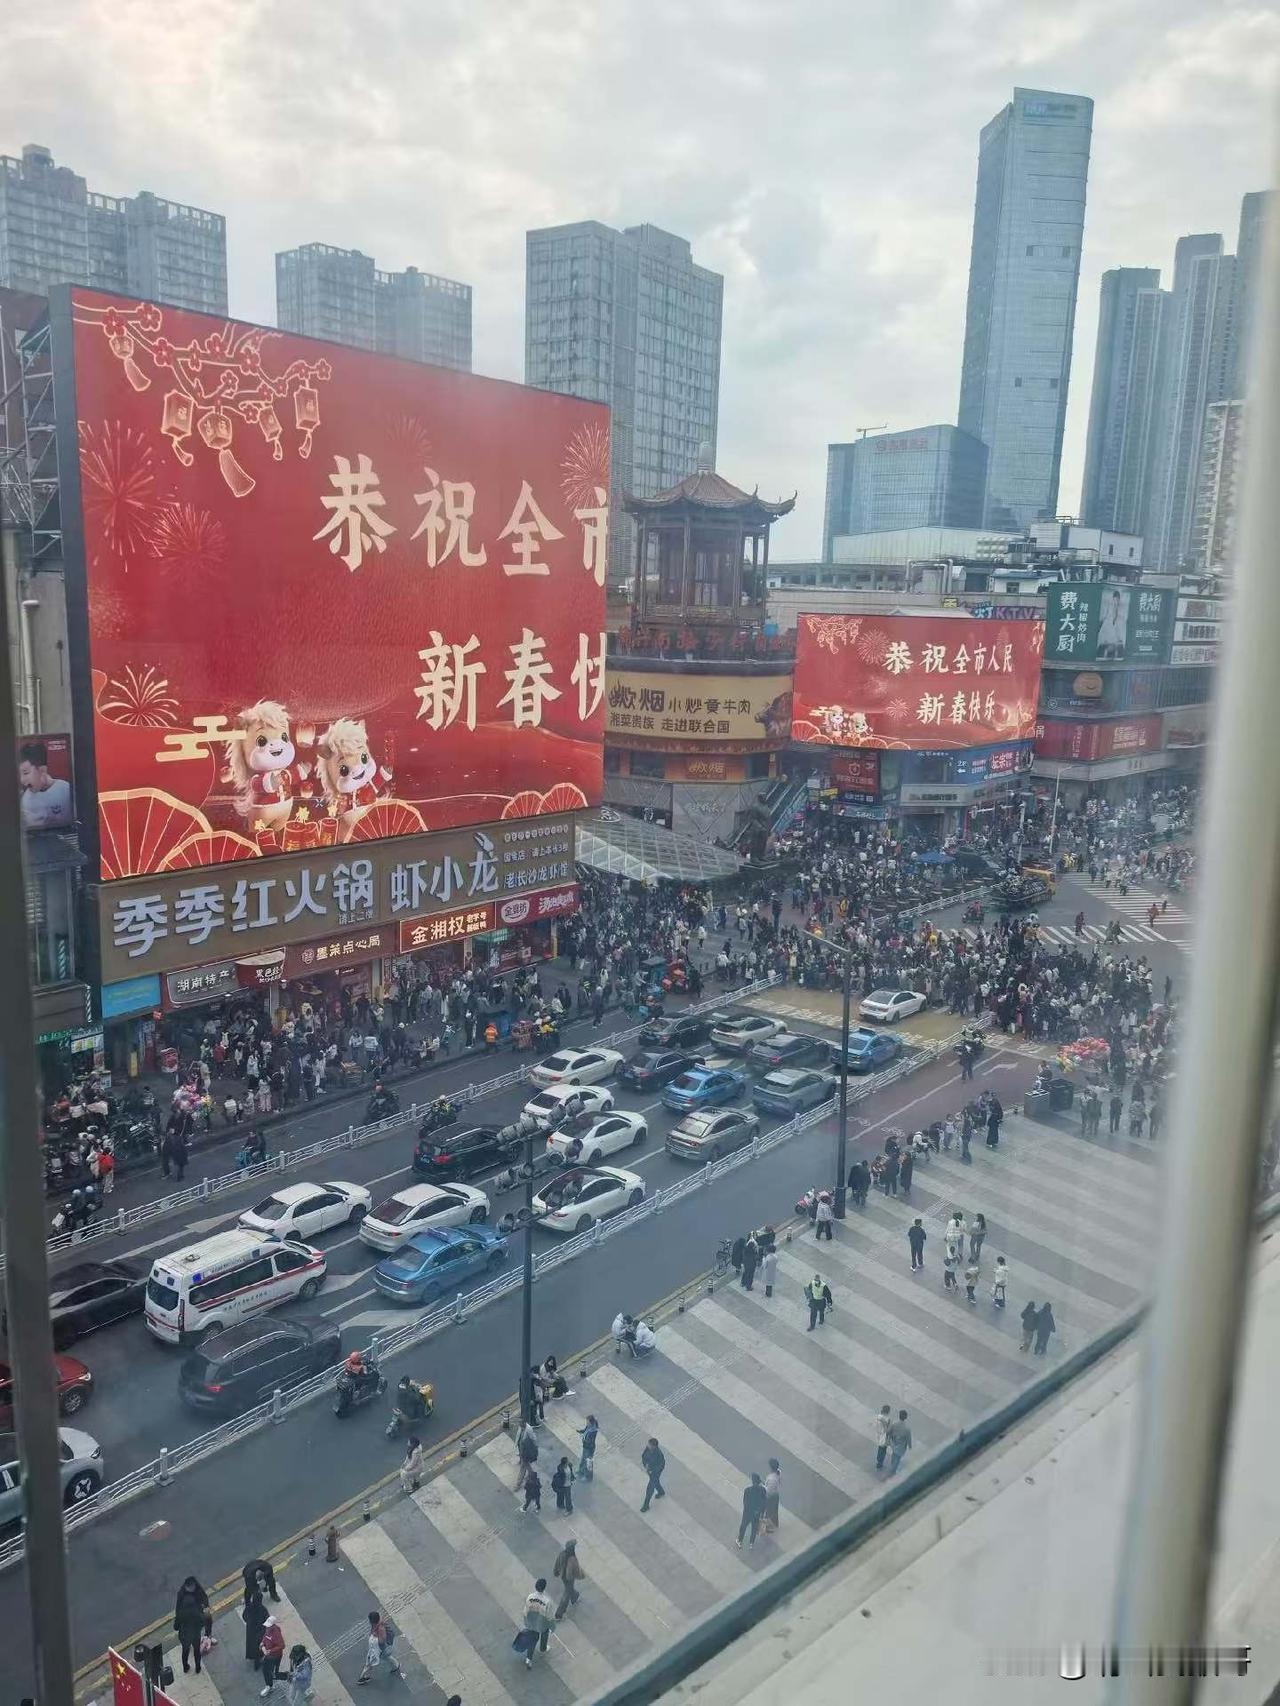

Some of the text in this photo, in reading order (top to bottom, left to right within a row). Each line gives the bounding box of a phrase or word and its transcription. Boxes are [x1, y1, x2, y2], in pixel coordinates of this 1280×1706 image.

[1056, 591, 1077, 652] 费大厨
[881, 641, 1013, 675] 恭祝全市人民
[668, 696, 751, 715] 小炒黄牛肉
[916, 690, 995, 725] 新春快乐
[661, 718, 730, 734] 走进联合国
[391, 832, 499, 912] 虾小龙
[113, 859, 377, 958] 季季红火锅
[411, 915, 466, 945] 金湘权
[316, 934, 381, 960] 墨茉点心局
[177, 969, 230, 992] 湖南特产
